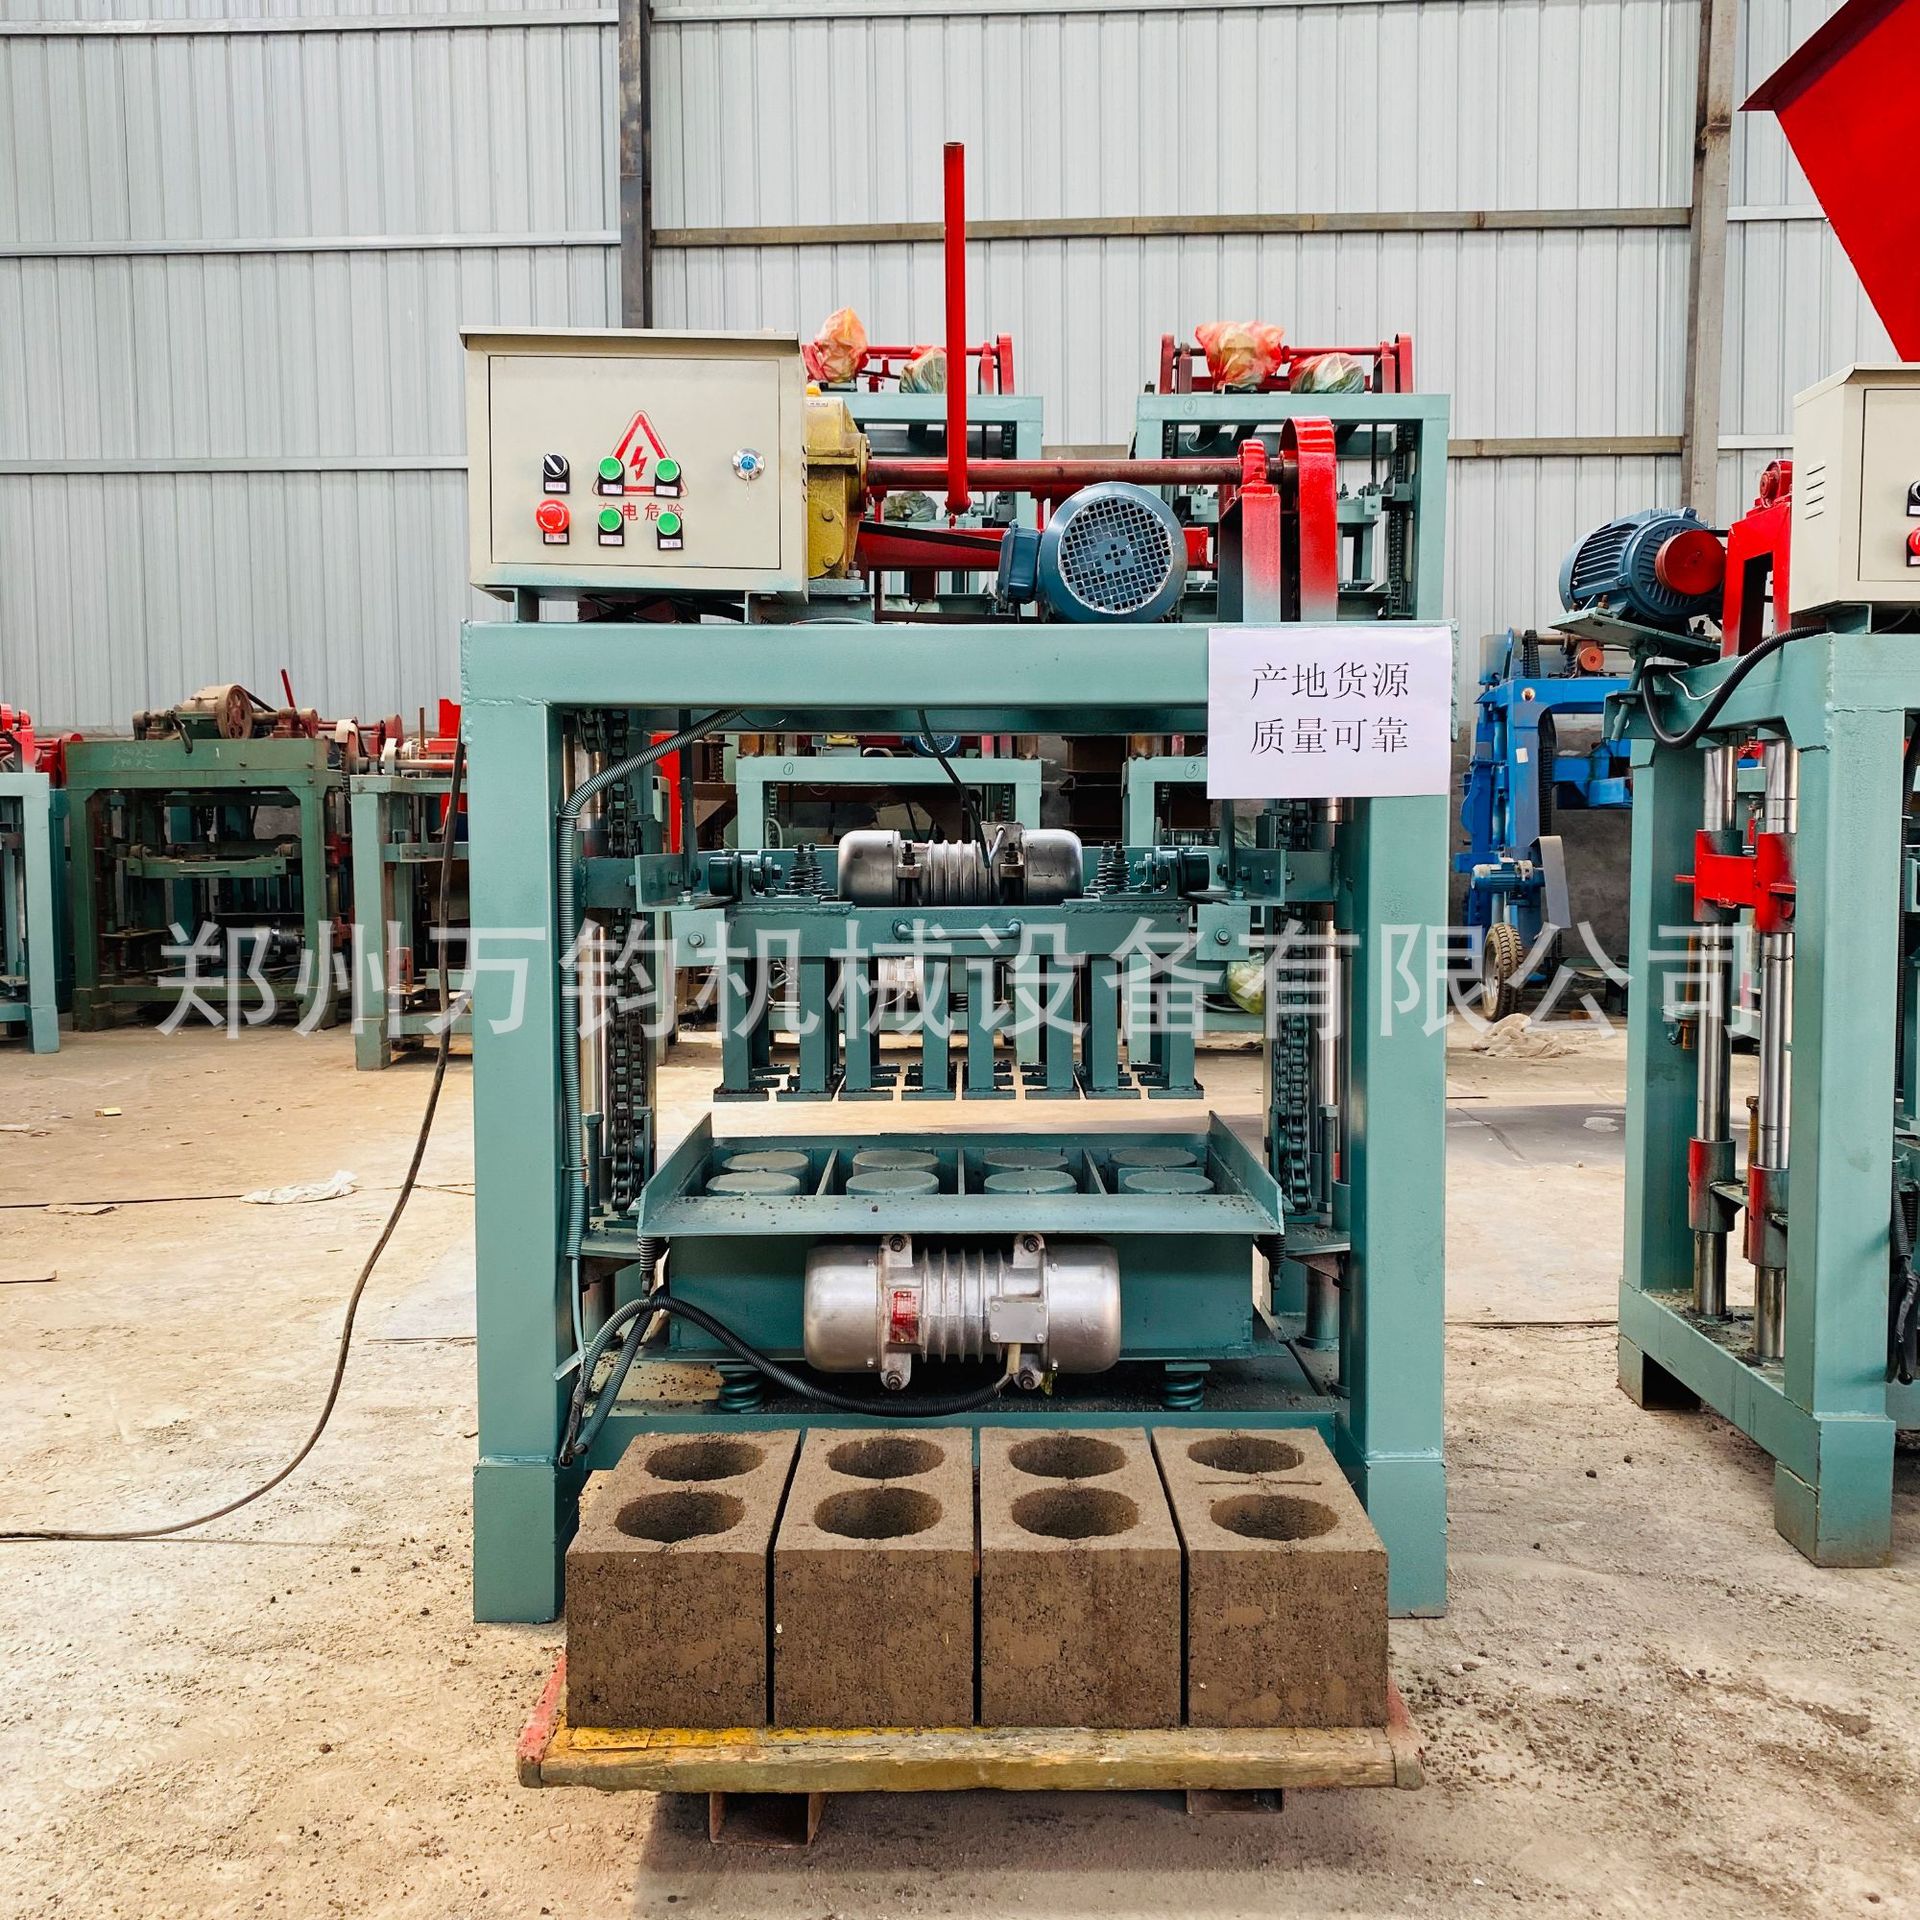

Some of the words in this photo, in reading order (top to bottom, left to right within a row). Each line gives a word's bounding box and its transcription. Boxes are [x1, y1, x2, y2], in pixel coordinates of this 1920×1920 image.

[599, 502, 684, 521] 电危险
[1250, 661, 1409, 700] 产地货源
[1250, 716, 1409, 755] 质量可靠
